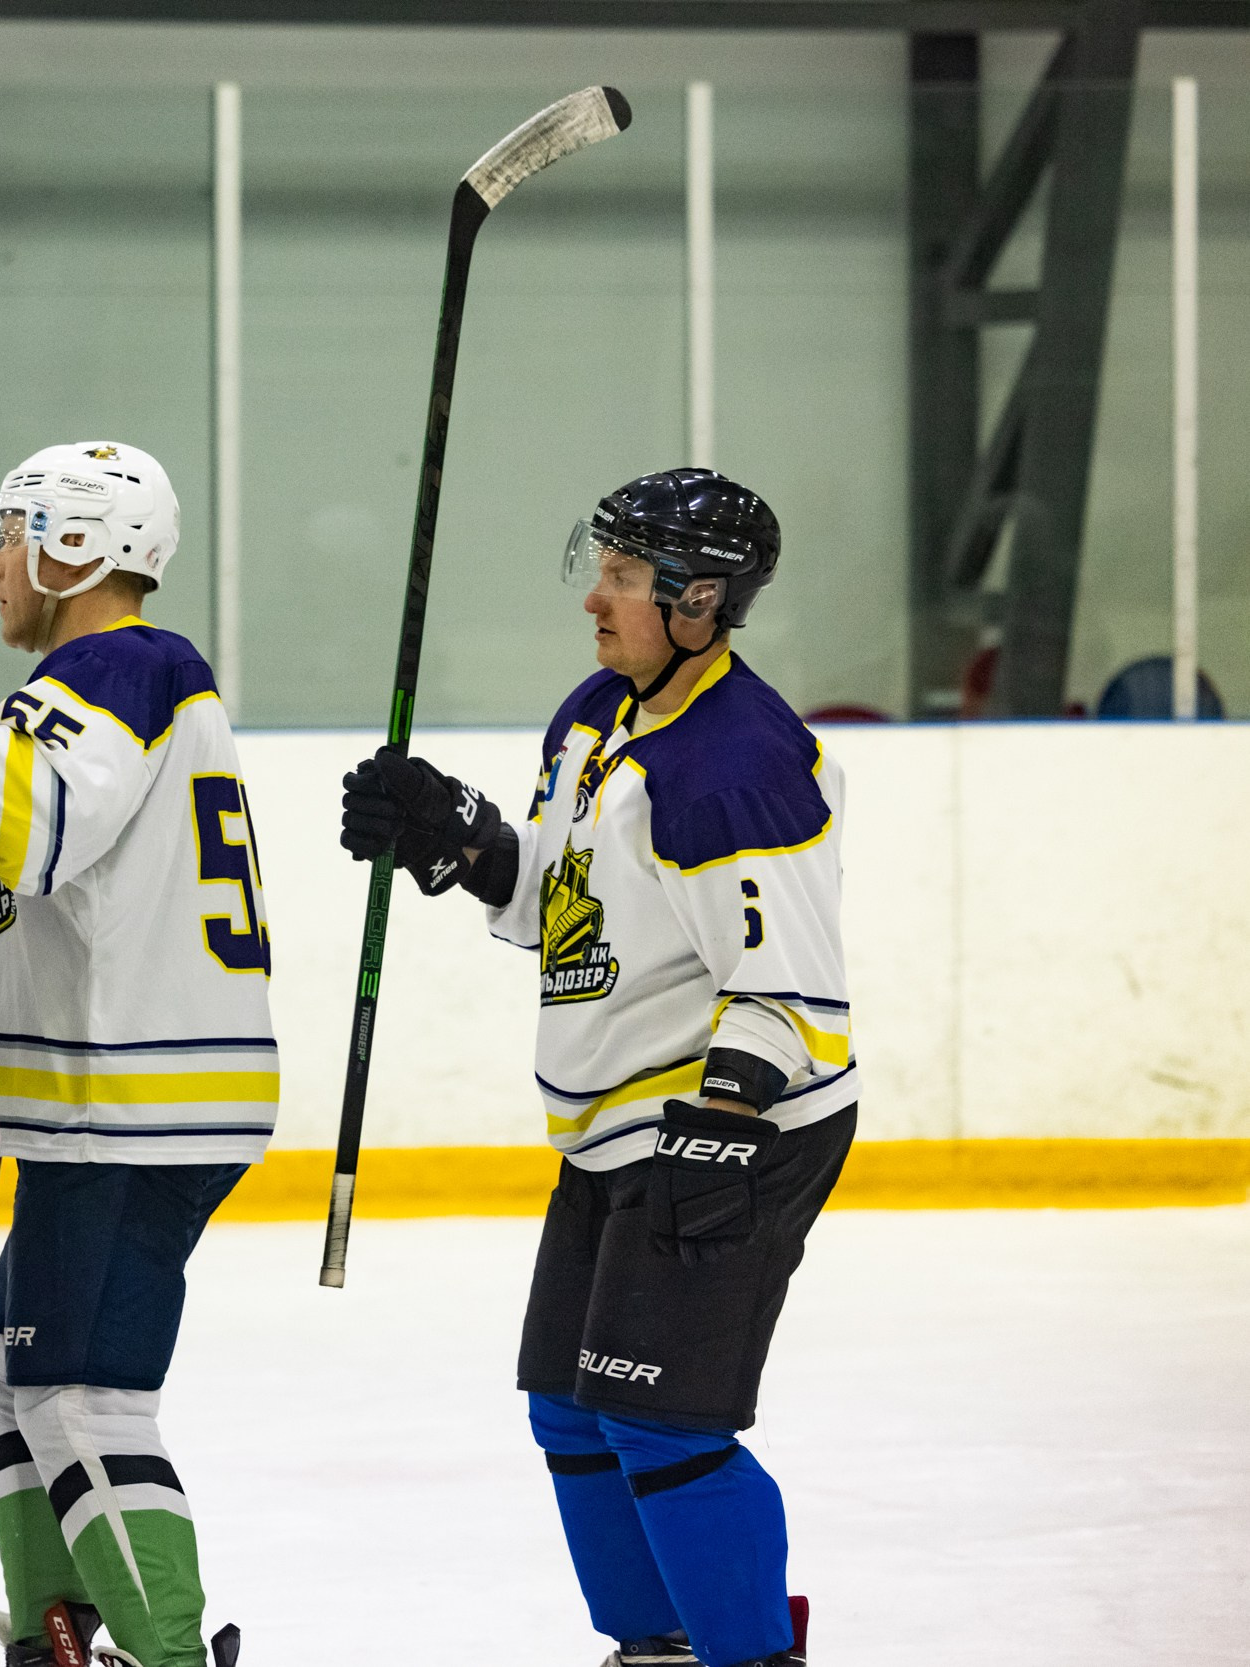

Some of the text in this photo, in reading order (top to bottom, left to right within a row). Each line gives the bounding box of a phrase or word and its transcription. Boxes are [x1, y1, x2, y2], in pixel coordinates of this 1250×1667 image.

[60, 477, 104, 491] BAUER
[700, 546, 745, 562] BAUER
[430, 860, 458, 889] BAUER
[706, 1078, 736, 1089] BAUER
[657, 1131, 758, 1166] UER
[53, 1616, 80, 1665] CCM
